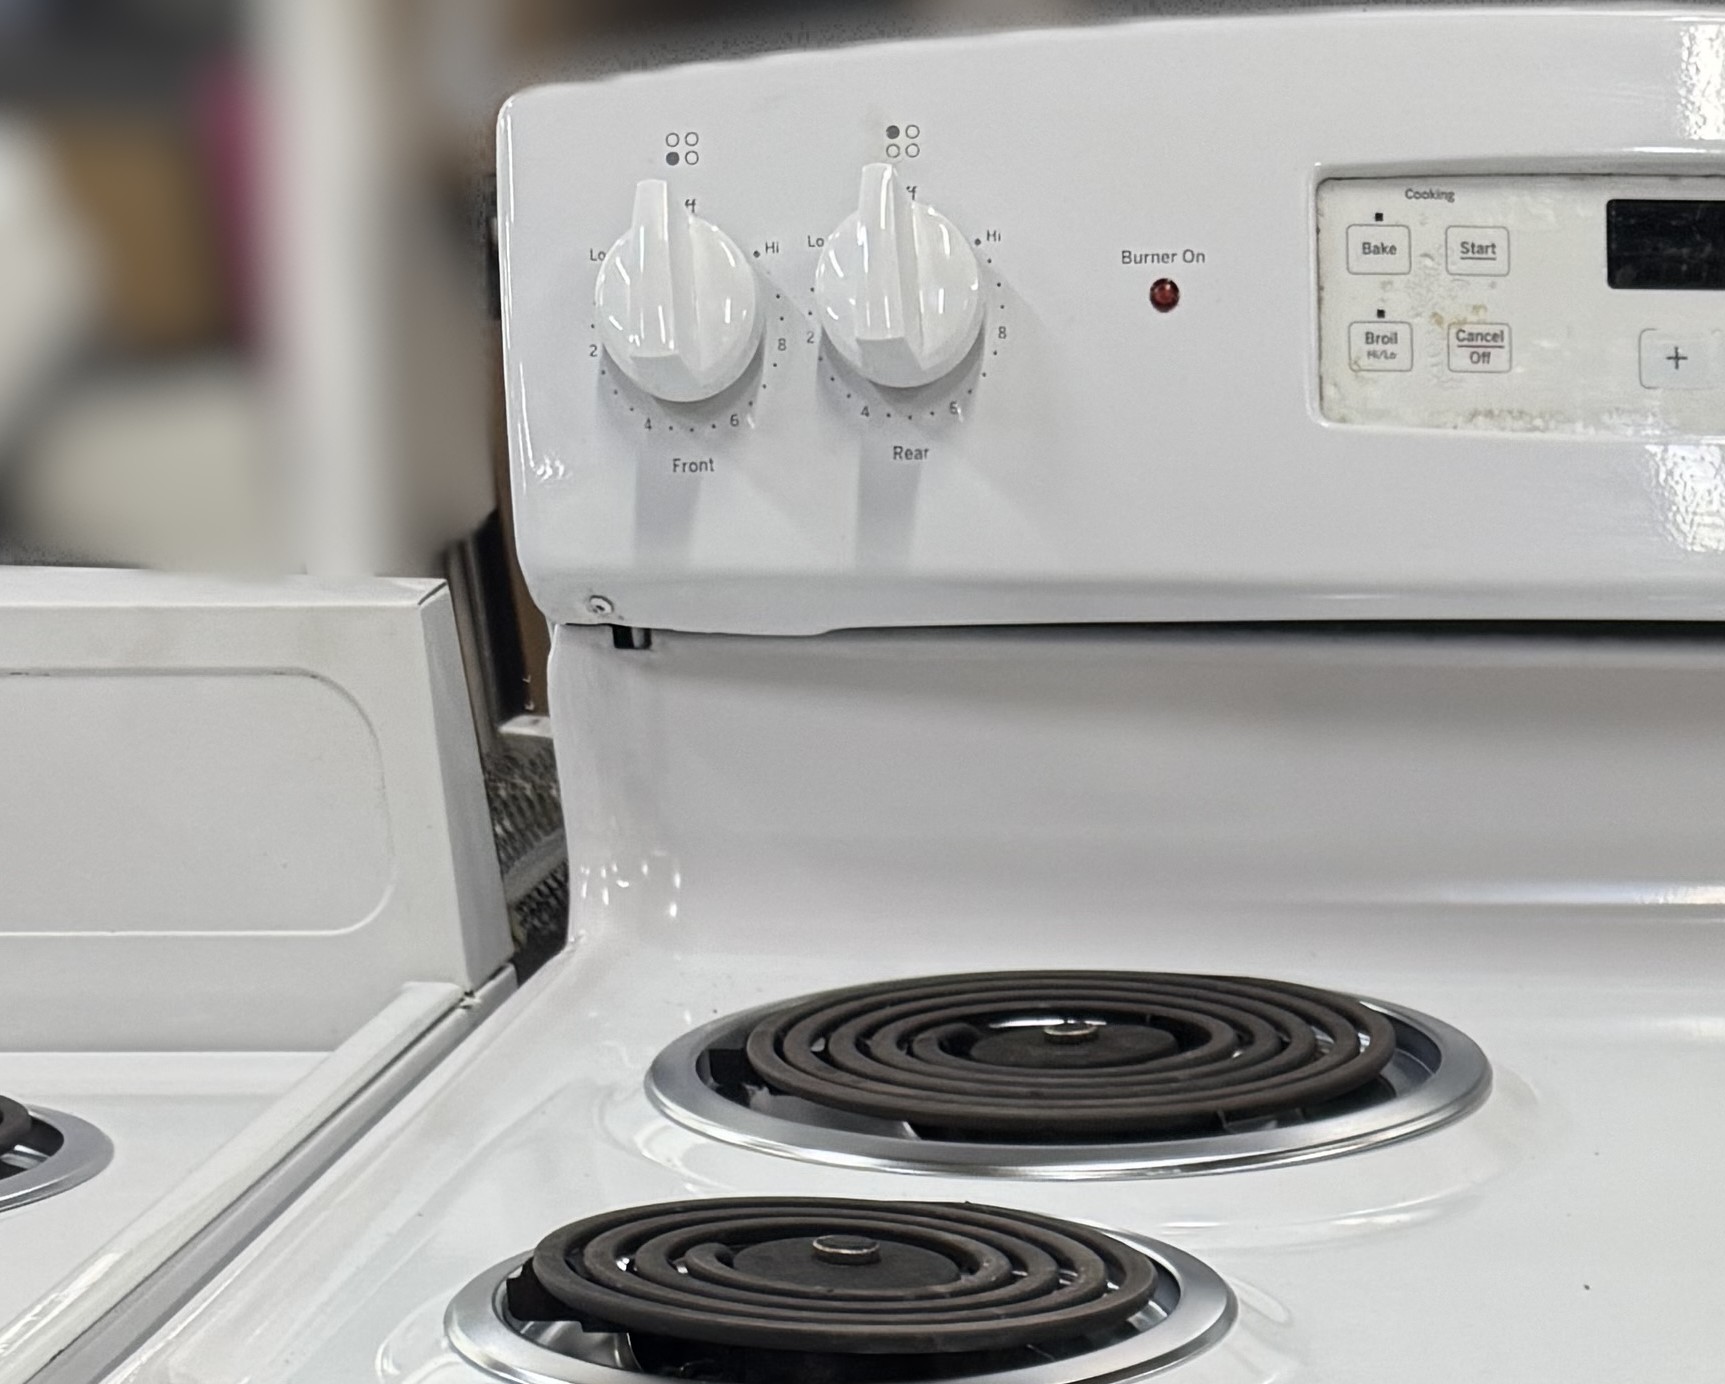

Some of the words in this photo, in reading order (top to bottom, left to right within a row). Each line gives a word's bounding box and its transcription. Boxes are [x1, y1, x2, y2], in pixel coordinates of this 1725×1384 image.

[1404, 188, 1455, 203] Cooking
[807, 235, 825, 248] Lo
[986, 229, 1001, 242] Hi
[765, 241, 780, 254] Hi
[1362, 241, 1397, 256] Bake
[1460, 241, 1497, 255] Start
[590, 248, 606, 262] Lo
[1121, 249, 1178, 265] Burner
[1182, 248, 1206, 264] On
[806, 330, 815, 344] 2
[998, 326, 1007, 339] 8
[1365, 331, 1398, 346] Broil
[1456, 329, 1505, 343] Cancel
[589, 344, 598, 357] 2
[777, 338, 787, 351] 8
[1367, 350, 1397, 360] Hi/Lo
[1469, 351, 1491, 365] Off
[860, 405, 870, 418] 4
[645, 417, 652, 430] 4
[730, 414, 739, 427] 6
[893, 445, 929, 461] Rear
[672, 458, 715, 473] Front
